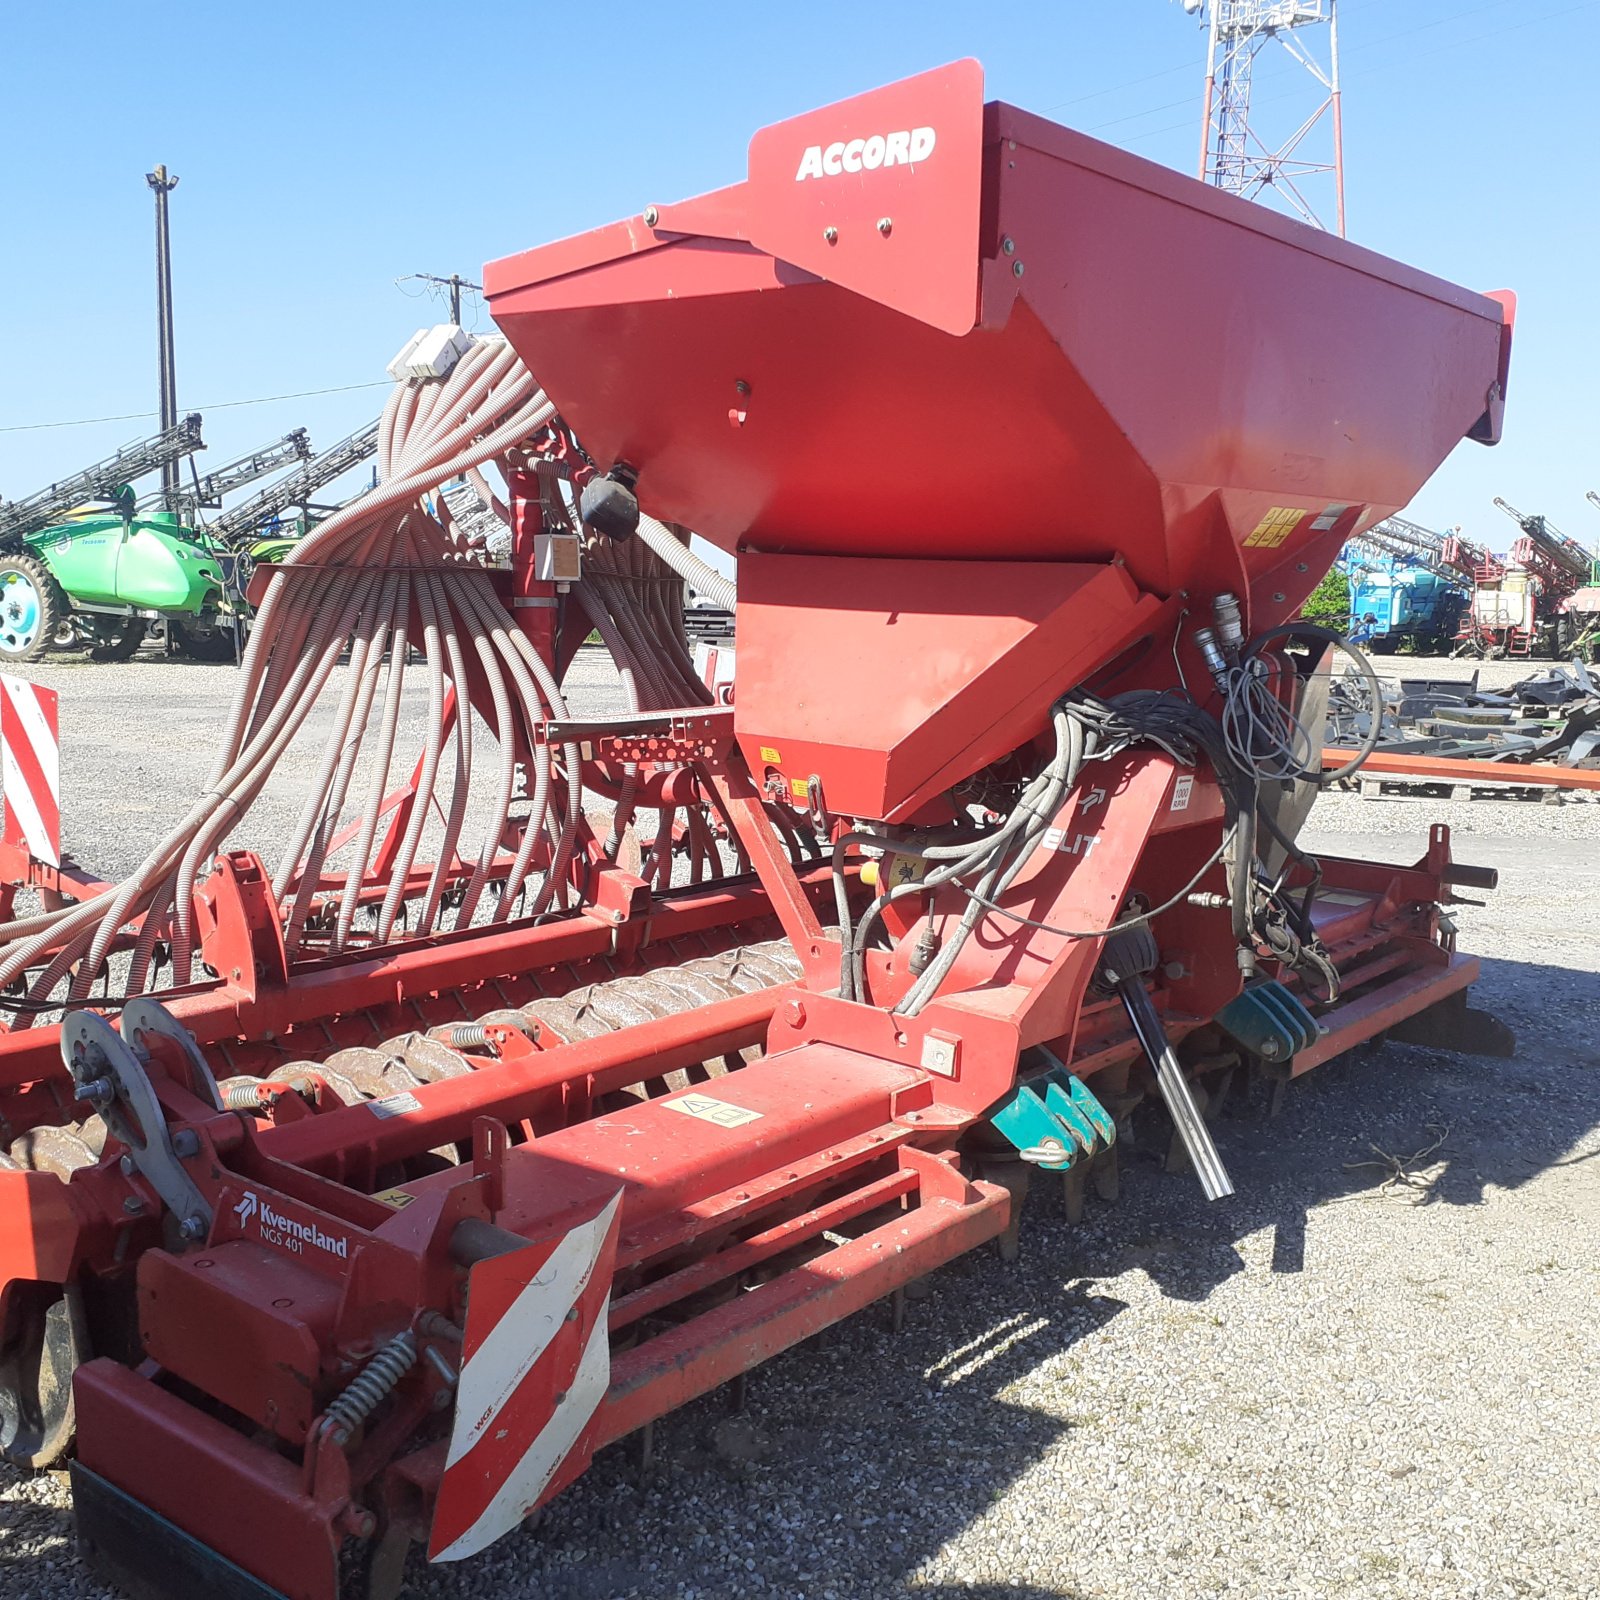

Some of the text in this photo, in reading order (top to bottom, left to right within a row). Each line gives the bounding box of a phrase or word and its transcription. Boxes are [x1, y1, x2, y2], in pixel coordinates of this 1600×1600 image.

[795, 126, 936, 182] ACCORD
[1173, 799, 1188, 808] RPM
[1175, 787, 1190, 799] 1000
[1041, 827, 1101, 858] ELIT
[260, 1201, 348, 1259] Kverneland
[260, 1225, 303, 1255] NGS 401
[473, 1405, 494, 1431] WGF
